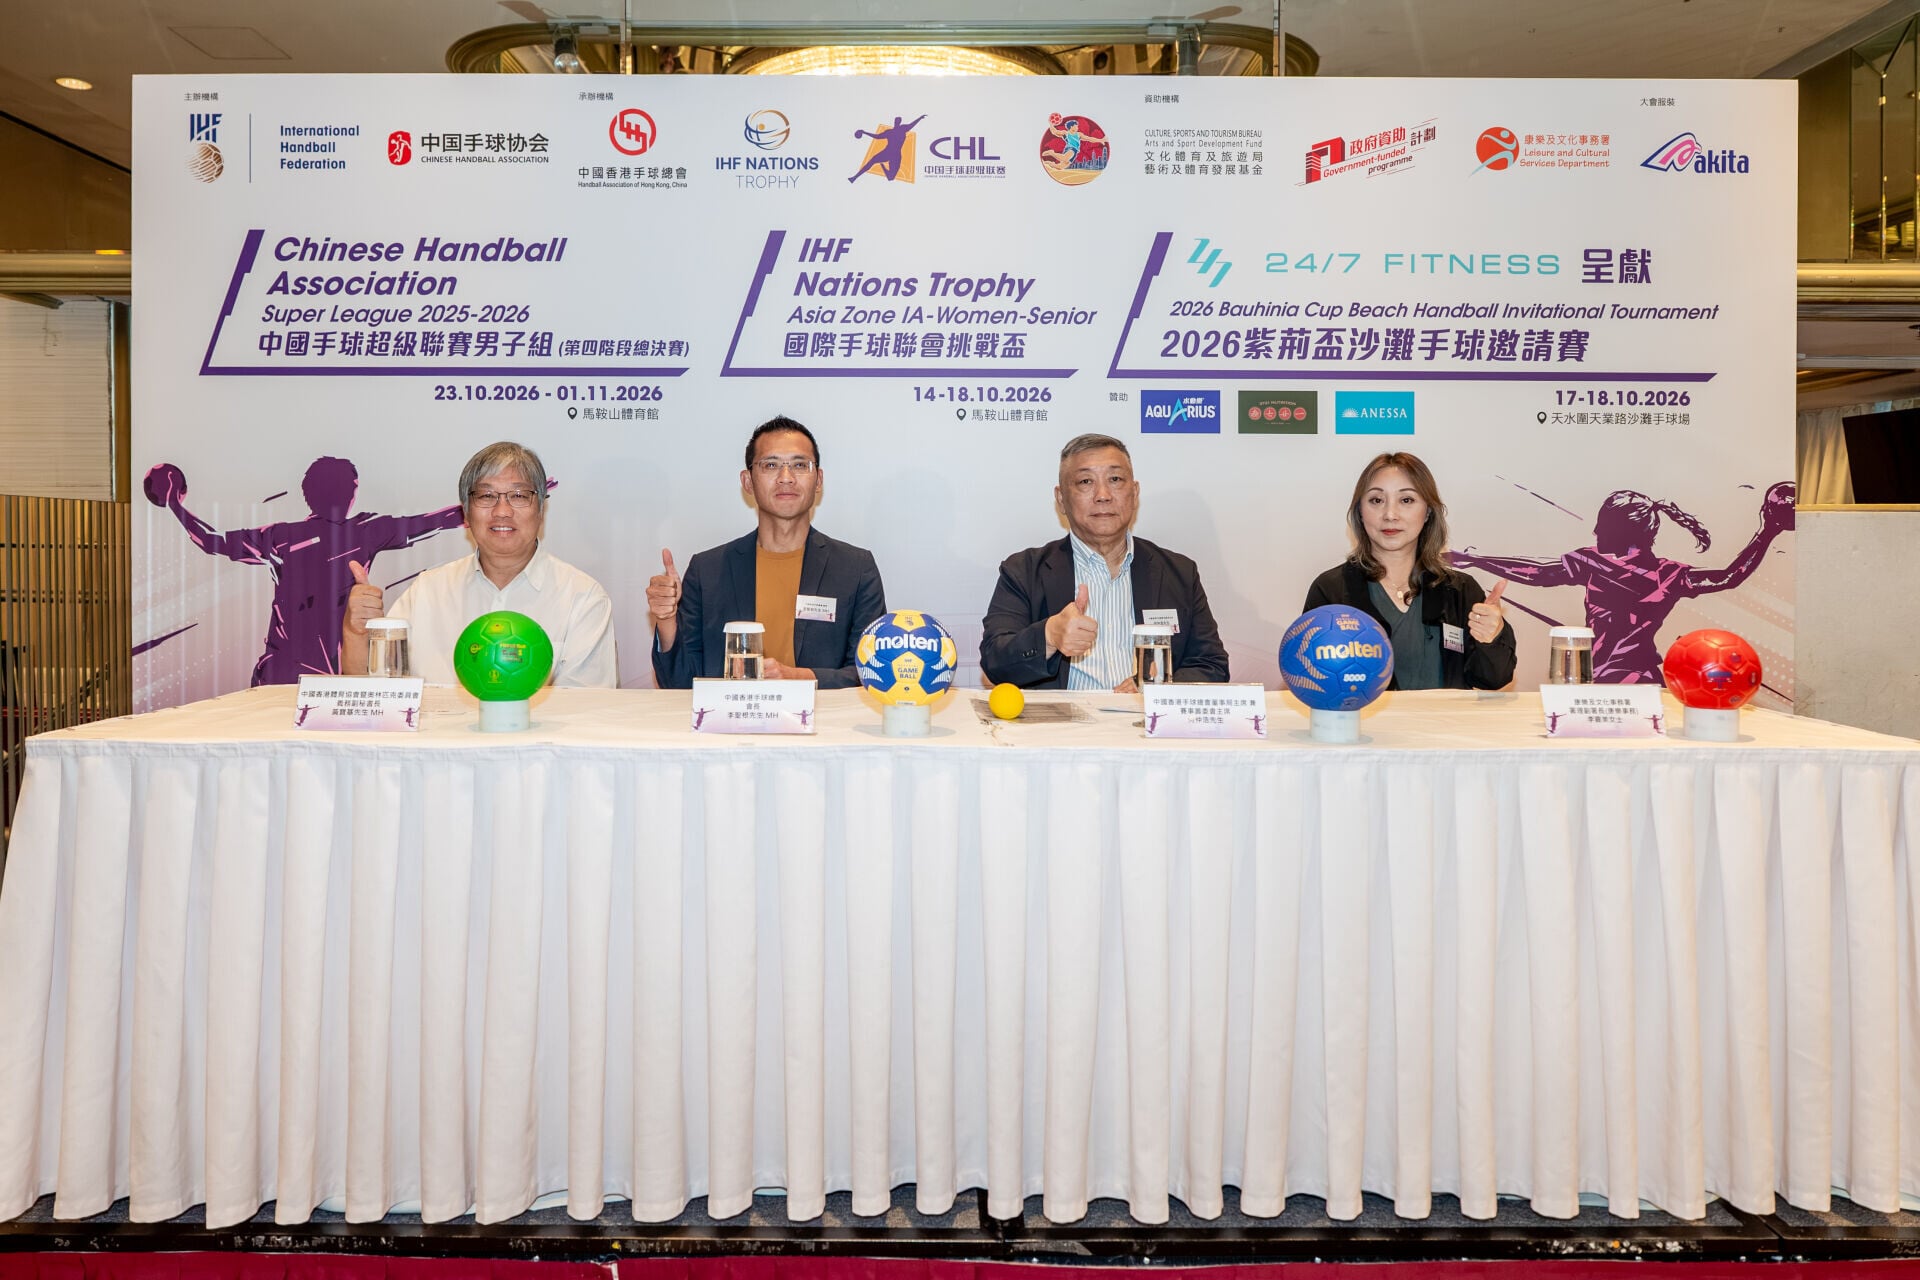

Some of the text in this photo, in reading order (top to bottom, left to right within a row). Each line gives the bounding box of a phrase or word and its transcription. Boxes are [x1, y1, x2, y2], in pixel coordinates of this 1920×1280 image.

[184, 92, 218, 101] 主辦機構
[579, 92, 613, 101] 承辦機構
[1145, 95, 1179, 103] 資助機構
[1640, 98, 1675, 106] 大會服裝
[190, 114, 222, 144] IHF
[281, 125, 359, 136] International
[1173, 129, 1194, 137] SPORTS
[1196, 129, 1209, 137] AND
[1210, 129, 1237, 137] TOURISM
[1239, 129, 1262, 137] BUREAU
[281, 142, 335, 152] Handball
[421, 133, 549, 152] 中国手球协会
[1145, 140, 1262, 149] Arts and Sport Development Fund
[1349, 126, 1436, 156] 政府資助 計劃
[1525, 134, 1609, 145] 康樂及文化事務署
[930, 137, 1000, 160] CHL
[1525, 148, 1610, 156] Leisure and Cultural
[281, 158, 345, 169] Federation
[716, 157, 818, 170] IHF NATIONS
[1144, 151, 1262, 162] 文化體育及旅遊局
[1323, 147, 1406, 178] Government-funded
[1694, 150, 1749, 173] akita
[1145, 164, 1262, 175] 藝術及體育發展基金
[1368, 155, 1412, 175] programme
[1520, 159, 1610, 170] Services Department
[579, 167, 686, 179] 中國香港手球總會
[736, 175, 799, 188] TROPHY
[275, 237, 568, 262] Chinese Handball
[798, 238, 853, 262] IHF
[1266, 249, 1651, 283] 24/7 FITNESS 呈獻
[266, 271, 457, 295] Association
[793, 272, 1036, 302] Nations Trophy
[262, 305, 530, 327] Super League 2025-2026
[786, 306, 1098, 325] Asia Zone IA-Women-Senior
[1170, 301, 1719, 320] 2026 Bauhinia Cup Beach Handball Invitational Tournament
[259, 331, 689, 357] 中國手球超級聯賽男子組 (第四階段總決賽)
[784, 332, 1027, 358] 國際手球聯會挑戰盃
[1161, 328, 1589, 362] 2026紫荊盃沙灘手球邀請賽
[435, 385, 539, 400] 23.10.2026
[557, 386, 662, 401] 01.11.2026
[914, 387, 1051, 402] 14-18.10.2026
[1110, 392, 1128, 401] 贊助
[1556, 390, 1690, 406] 17-18.10.2026
[583, 408, 659, 420] 馬鞍山體育館
[972, 409, 1048, 421] 馬鞍山體育館
[1145, 398, 1215, 426] AQUARIUS
[1361, 408, 1407, 418] ANESSA
[1552, 413, 1690, 425] 天水圍天業路沙灘手球場
[876, 633, 937, 652] molten
[1316, 641, 1382, 660] molten
